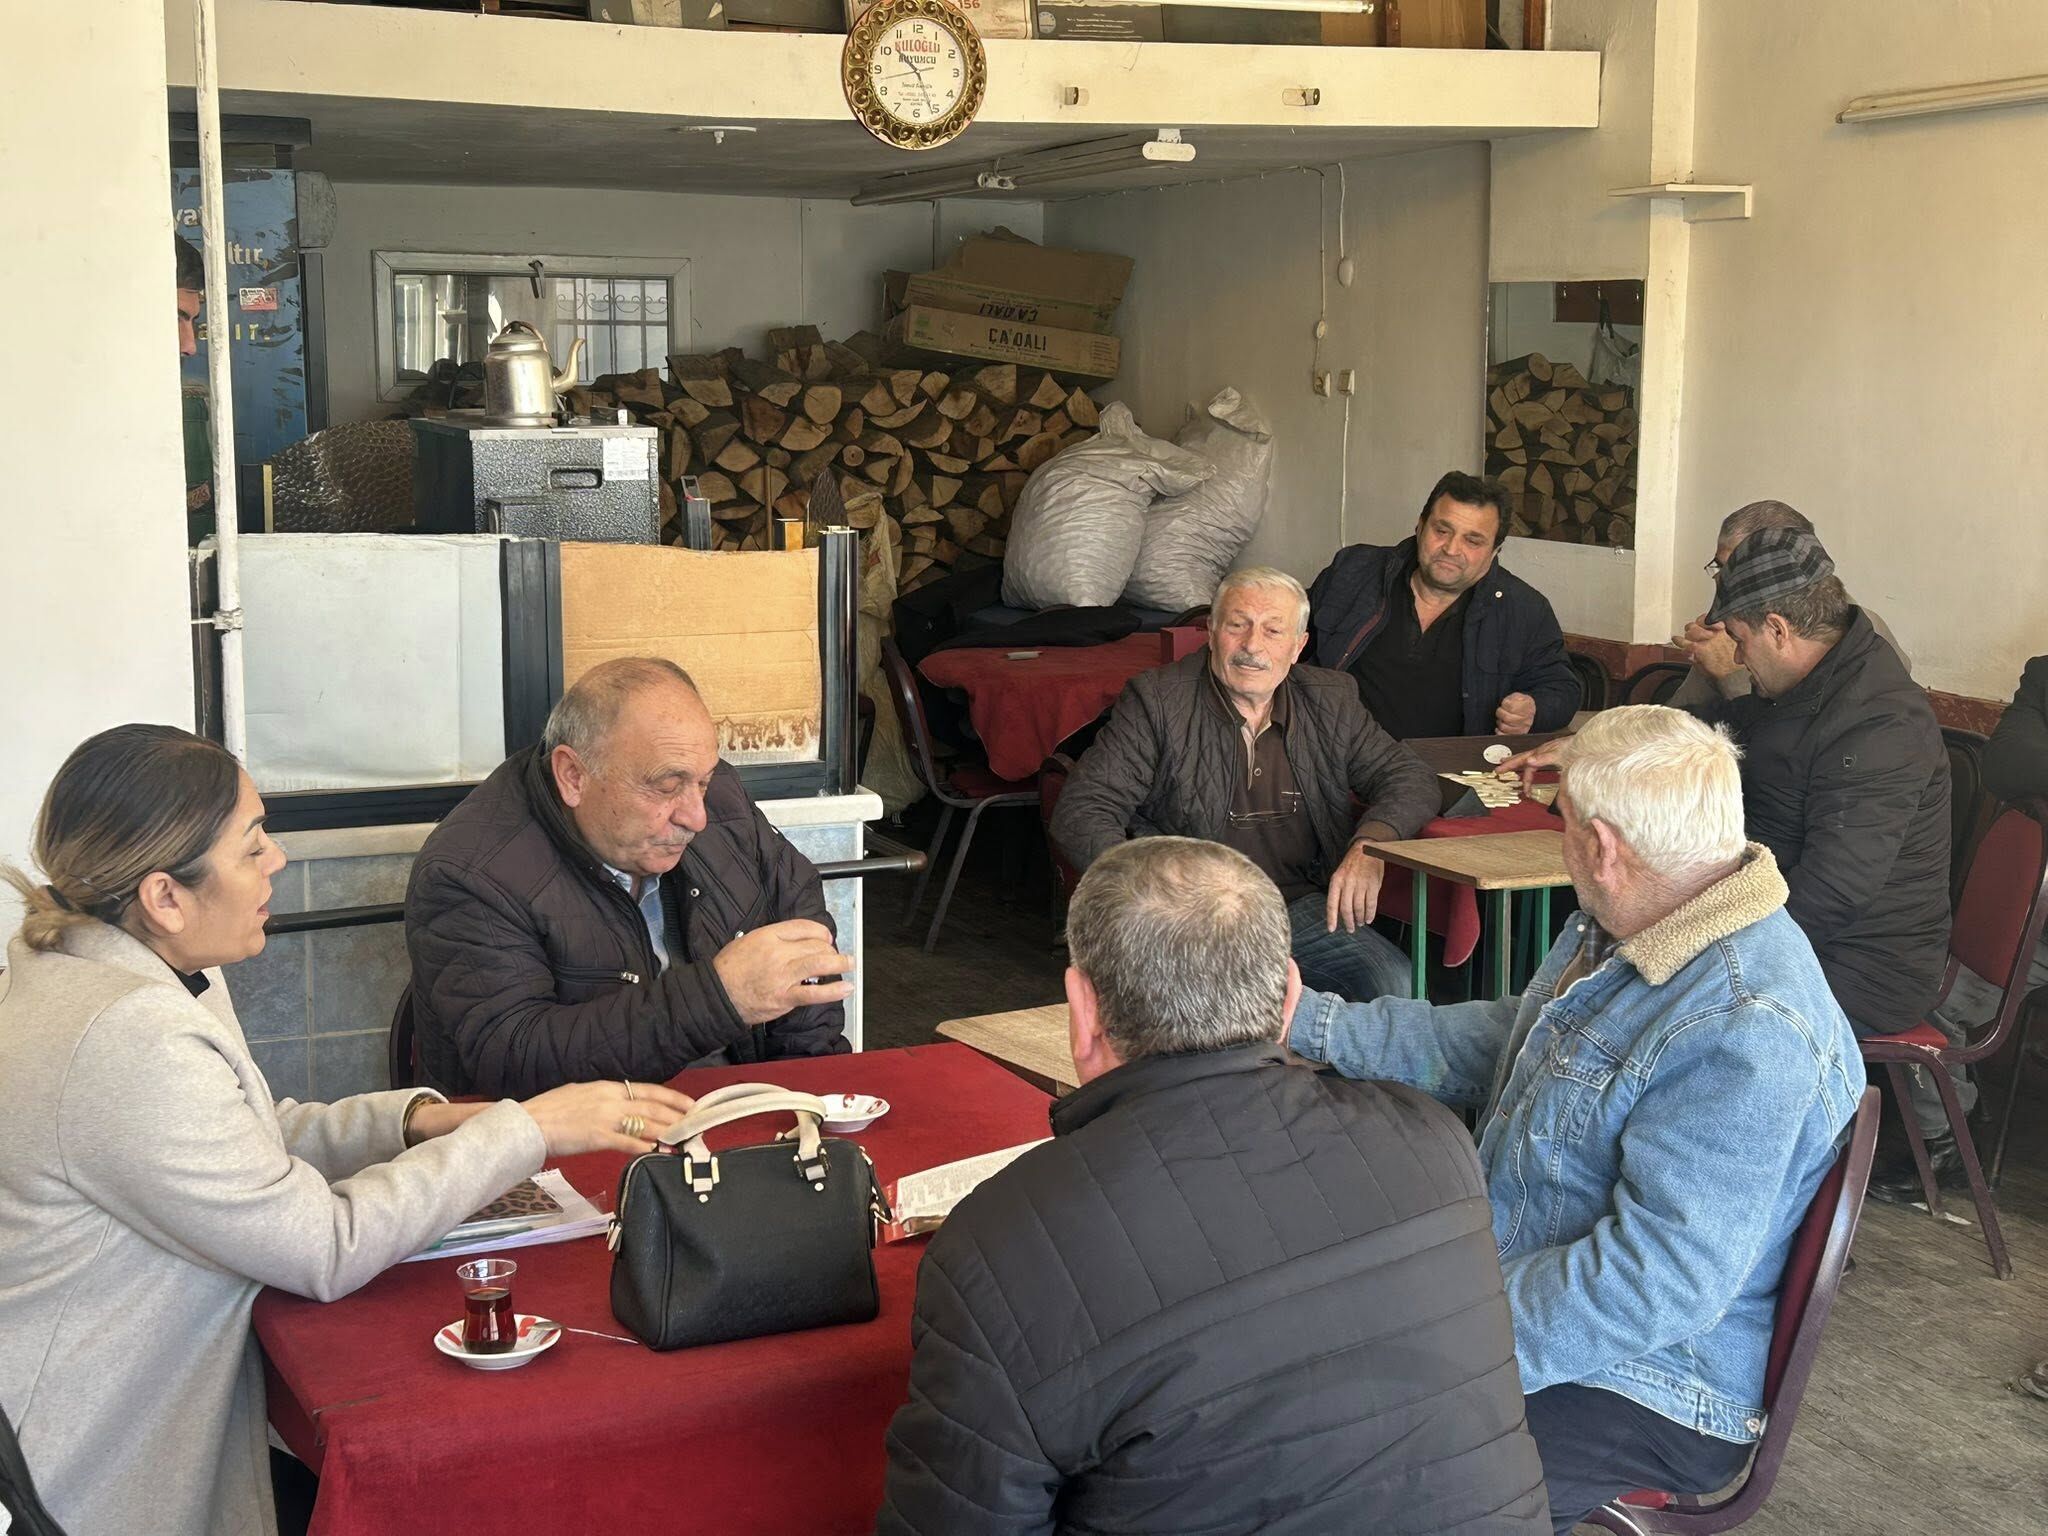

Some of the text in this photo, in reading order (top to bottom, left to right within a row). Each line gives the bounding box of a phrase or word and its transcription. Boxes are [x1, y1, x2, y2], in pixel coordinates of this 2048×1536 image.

[896, 29, 902, 39] 11
[912, 24, 923, 34] 12
[880, 46, 892, 56] 10
[947, 49, 956, 59] 2
[873, 65, 882, 75] 9
[952, 68, 960, 78] 3
[879, 86, 888, 96] 8
[945, 90, 955, 99] 4
[893, 103, 902, 114] 7
[912, 109, 921, 118] 6
[932, 104, 940, 114] 5
